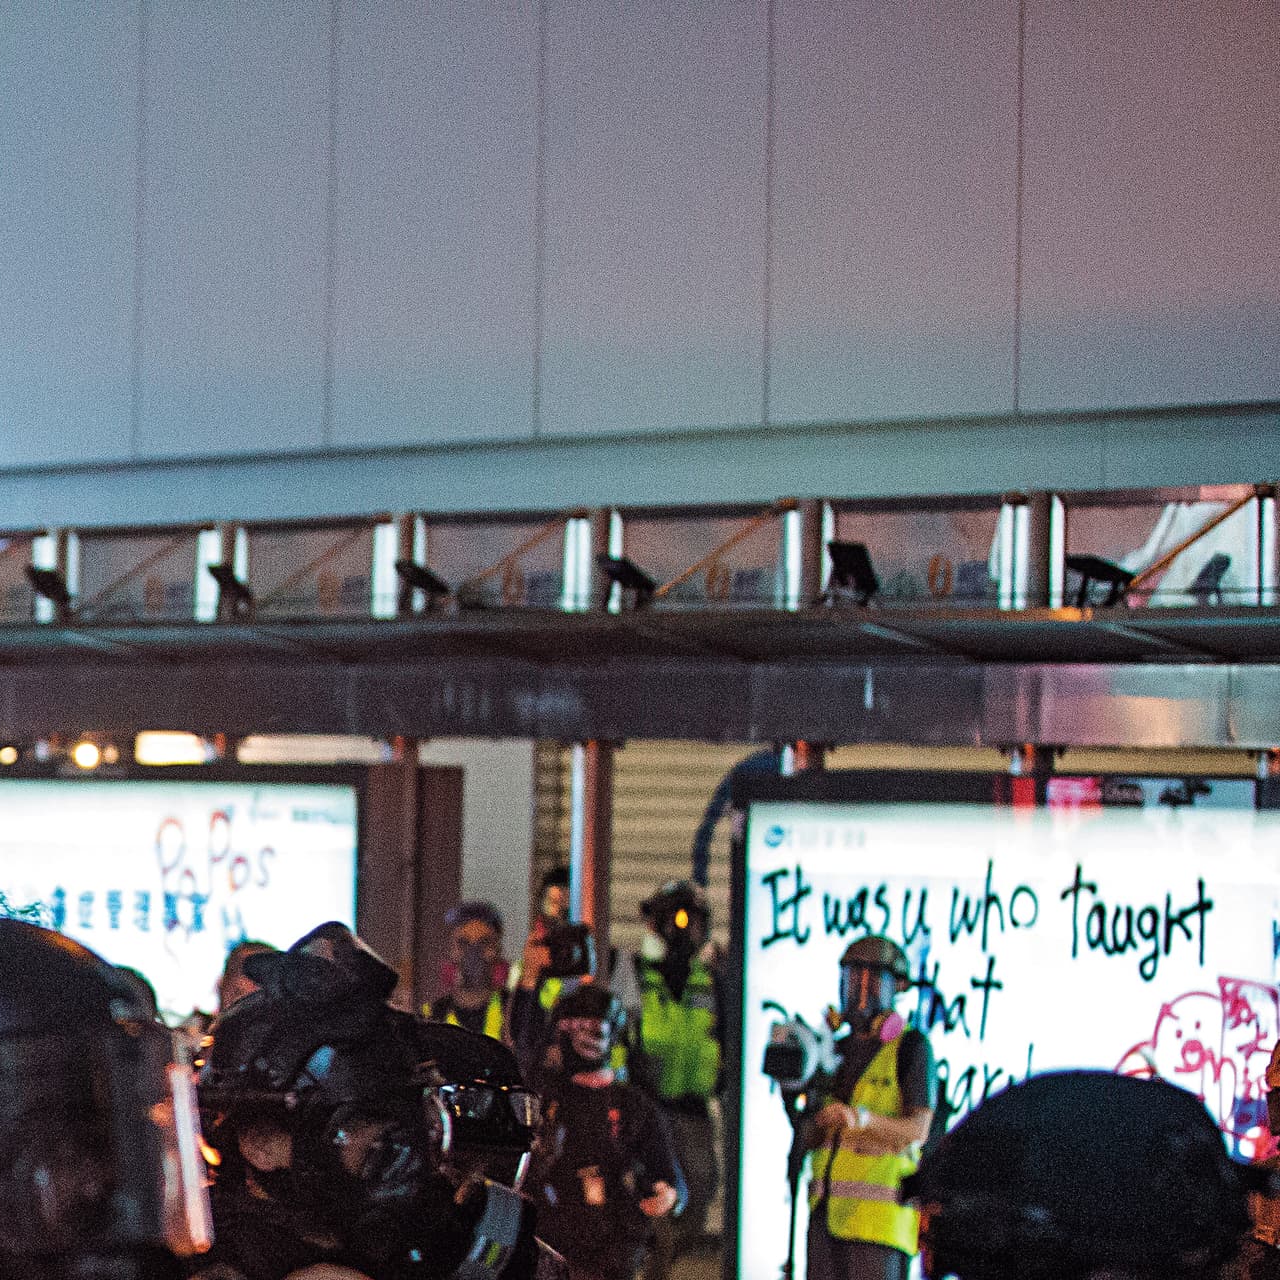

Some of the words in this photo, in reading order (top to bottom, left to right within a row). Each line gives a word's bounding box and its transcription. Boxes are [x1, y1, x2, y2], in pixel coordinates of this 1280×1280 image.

[760, 863, 812, 949] It
[902, 886, 932, 945] u
[948, 857, 1039, 952] who
